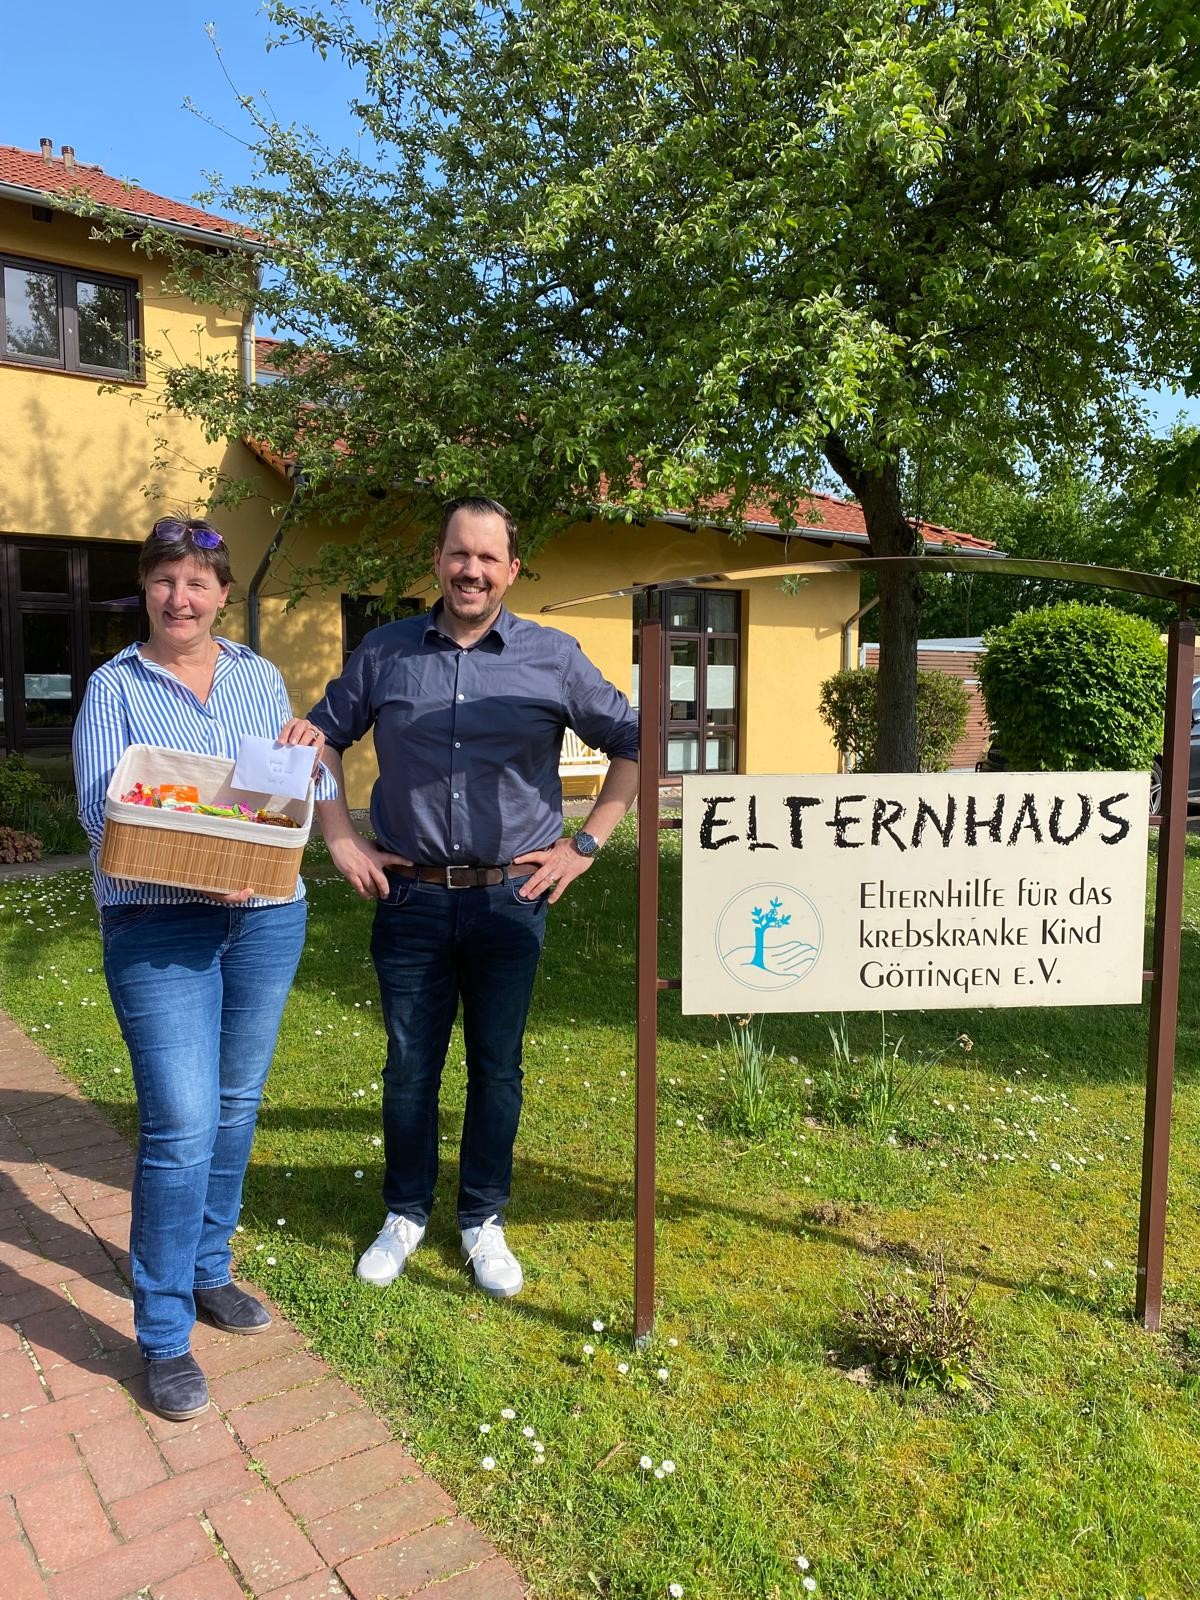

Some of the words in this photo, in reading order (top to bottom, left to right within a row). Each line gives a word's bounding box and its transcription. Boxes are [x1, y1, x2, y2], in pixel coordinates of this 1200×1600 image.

[700, 793, 1131, 852] ELTERNHAUS
[860, 878, 1004, 908] Elternhilfe
[1018, 877, 1056, 906] für
[1069, 876, 1112, 905] das
[859, 917, 1028, 947] krebskranke
[1041, 916, 1101, 944] Kind
[859, 960, 1000, 993] Göttingen
[1014, 957, 1062, 985] e.V.
